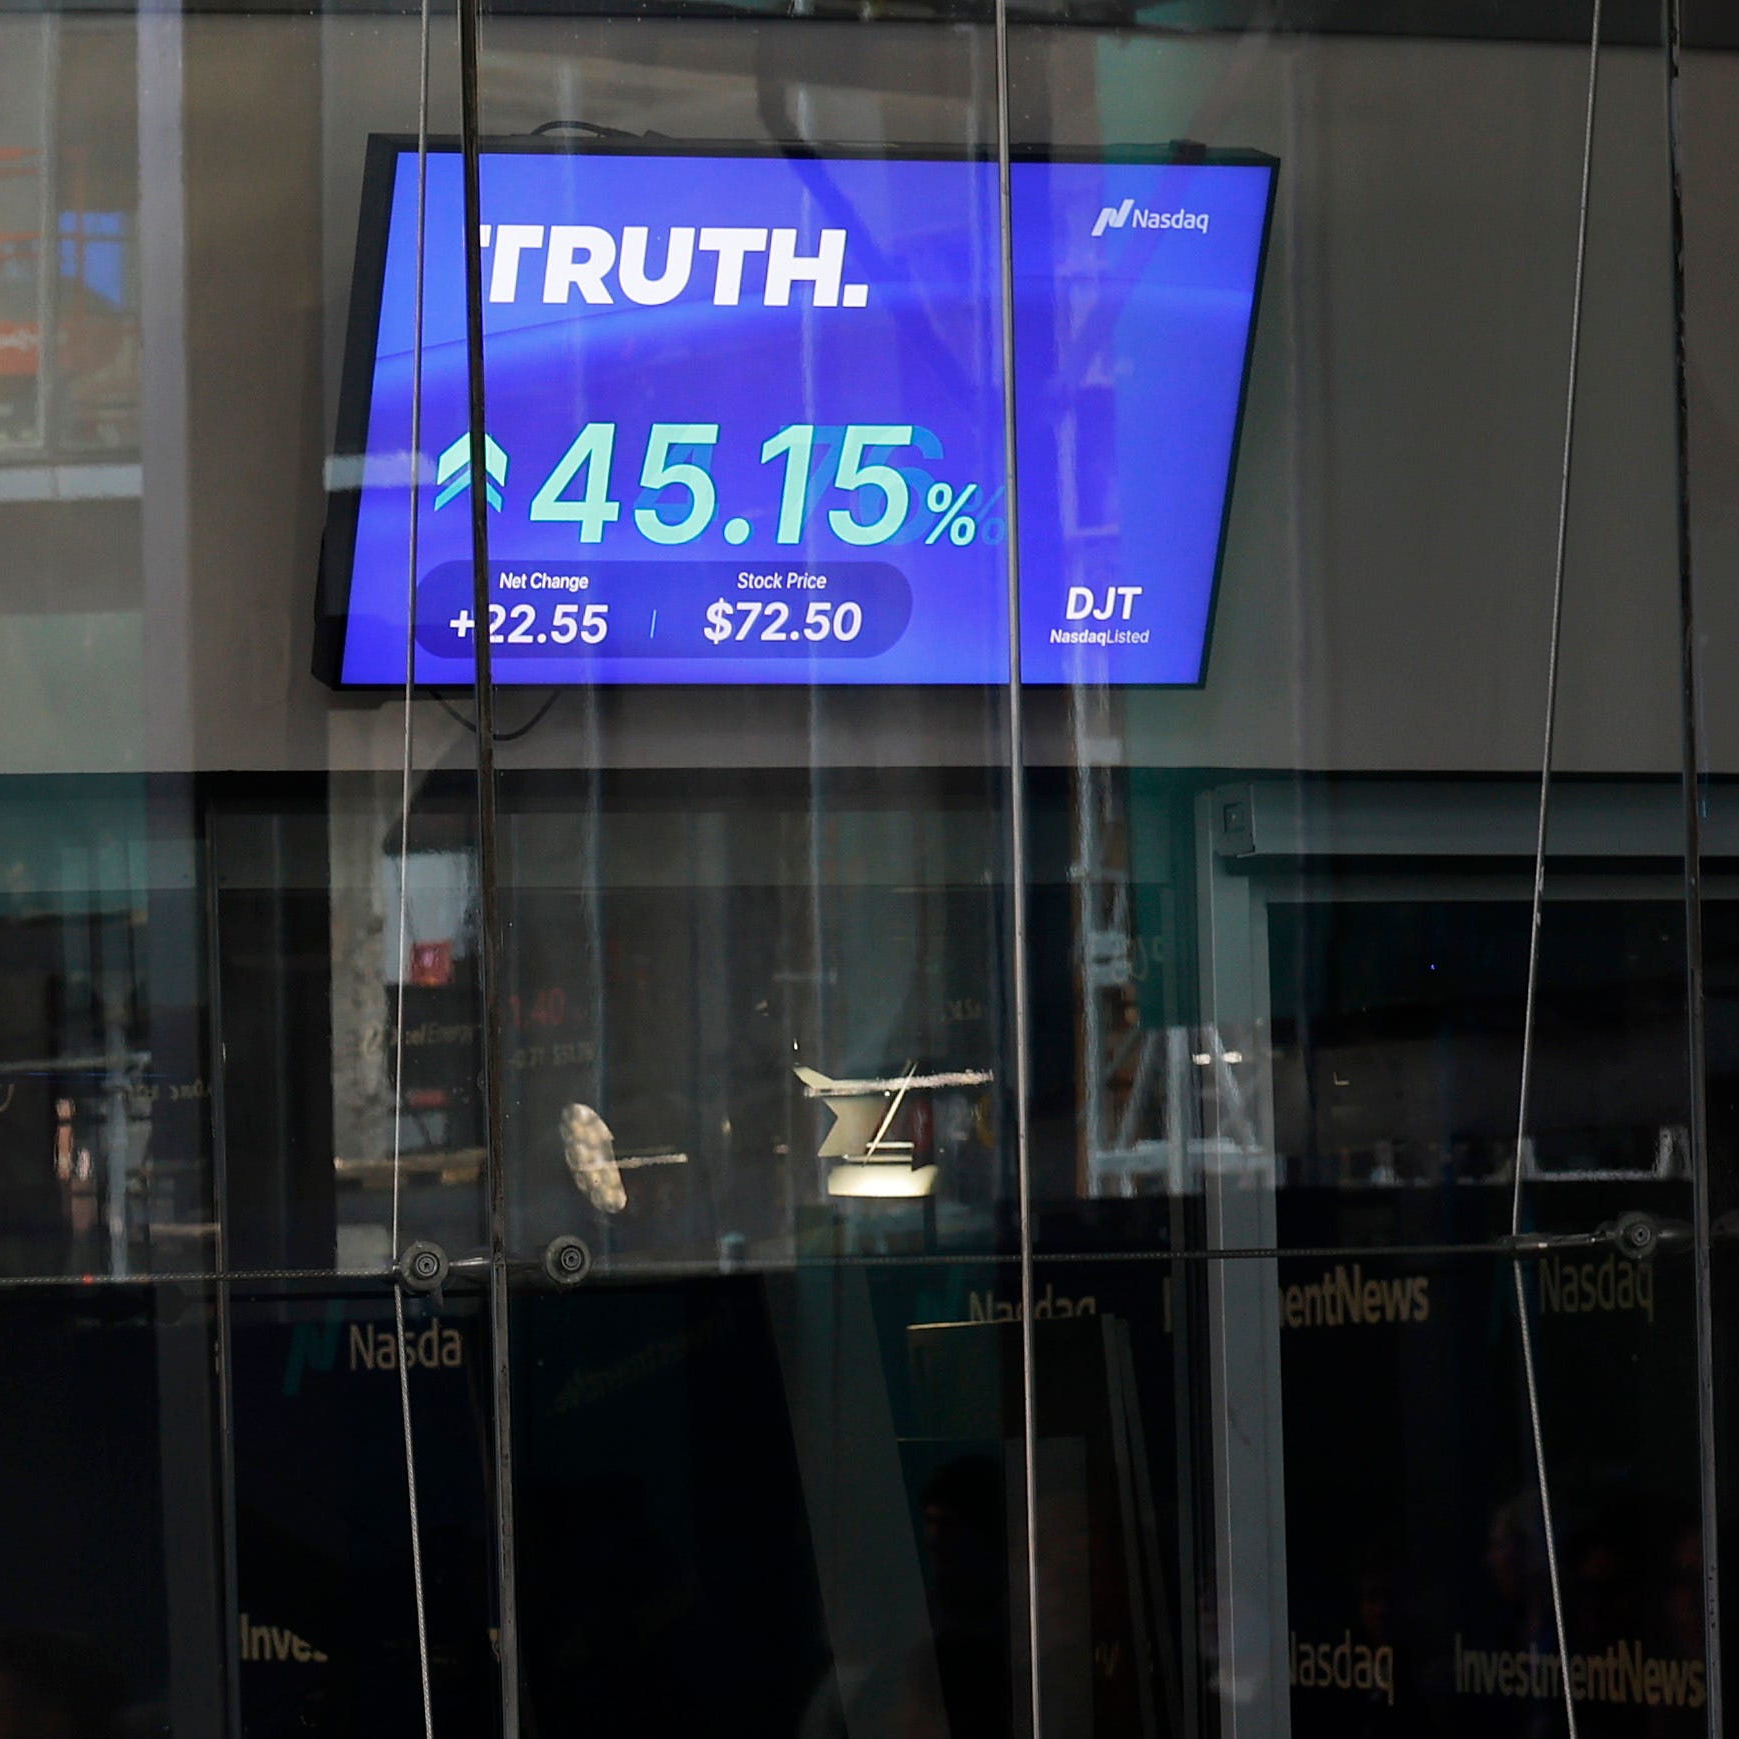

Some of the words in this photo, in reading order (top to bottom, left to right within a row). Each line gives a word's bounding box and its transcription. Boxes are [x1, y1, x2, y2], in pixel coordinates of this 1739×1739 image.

[1131, 207, 1209, 235] Nasdaq
[478, 223, 868, 308] TRUTH.
[499, 572, 529, 591] Net
[531, 572, 589, 593] Change
[736, 571, 783, 590] Stock
[785, 571, 827, 591] Price
[448, 602, 609, 645] +22.55
[701, 598, 862, 646] $72.50
[1064, 586, 1142, 622] DJT
[1048, 626, 1150, 647] NasdaqListed
[1539, 1252, 1655, 1323] Nasdaq
[349, 1319, 463, 1371] Nasda
[1454, 1632, 1706, 1708] InvestmentNews
